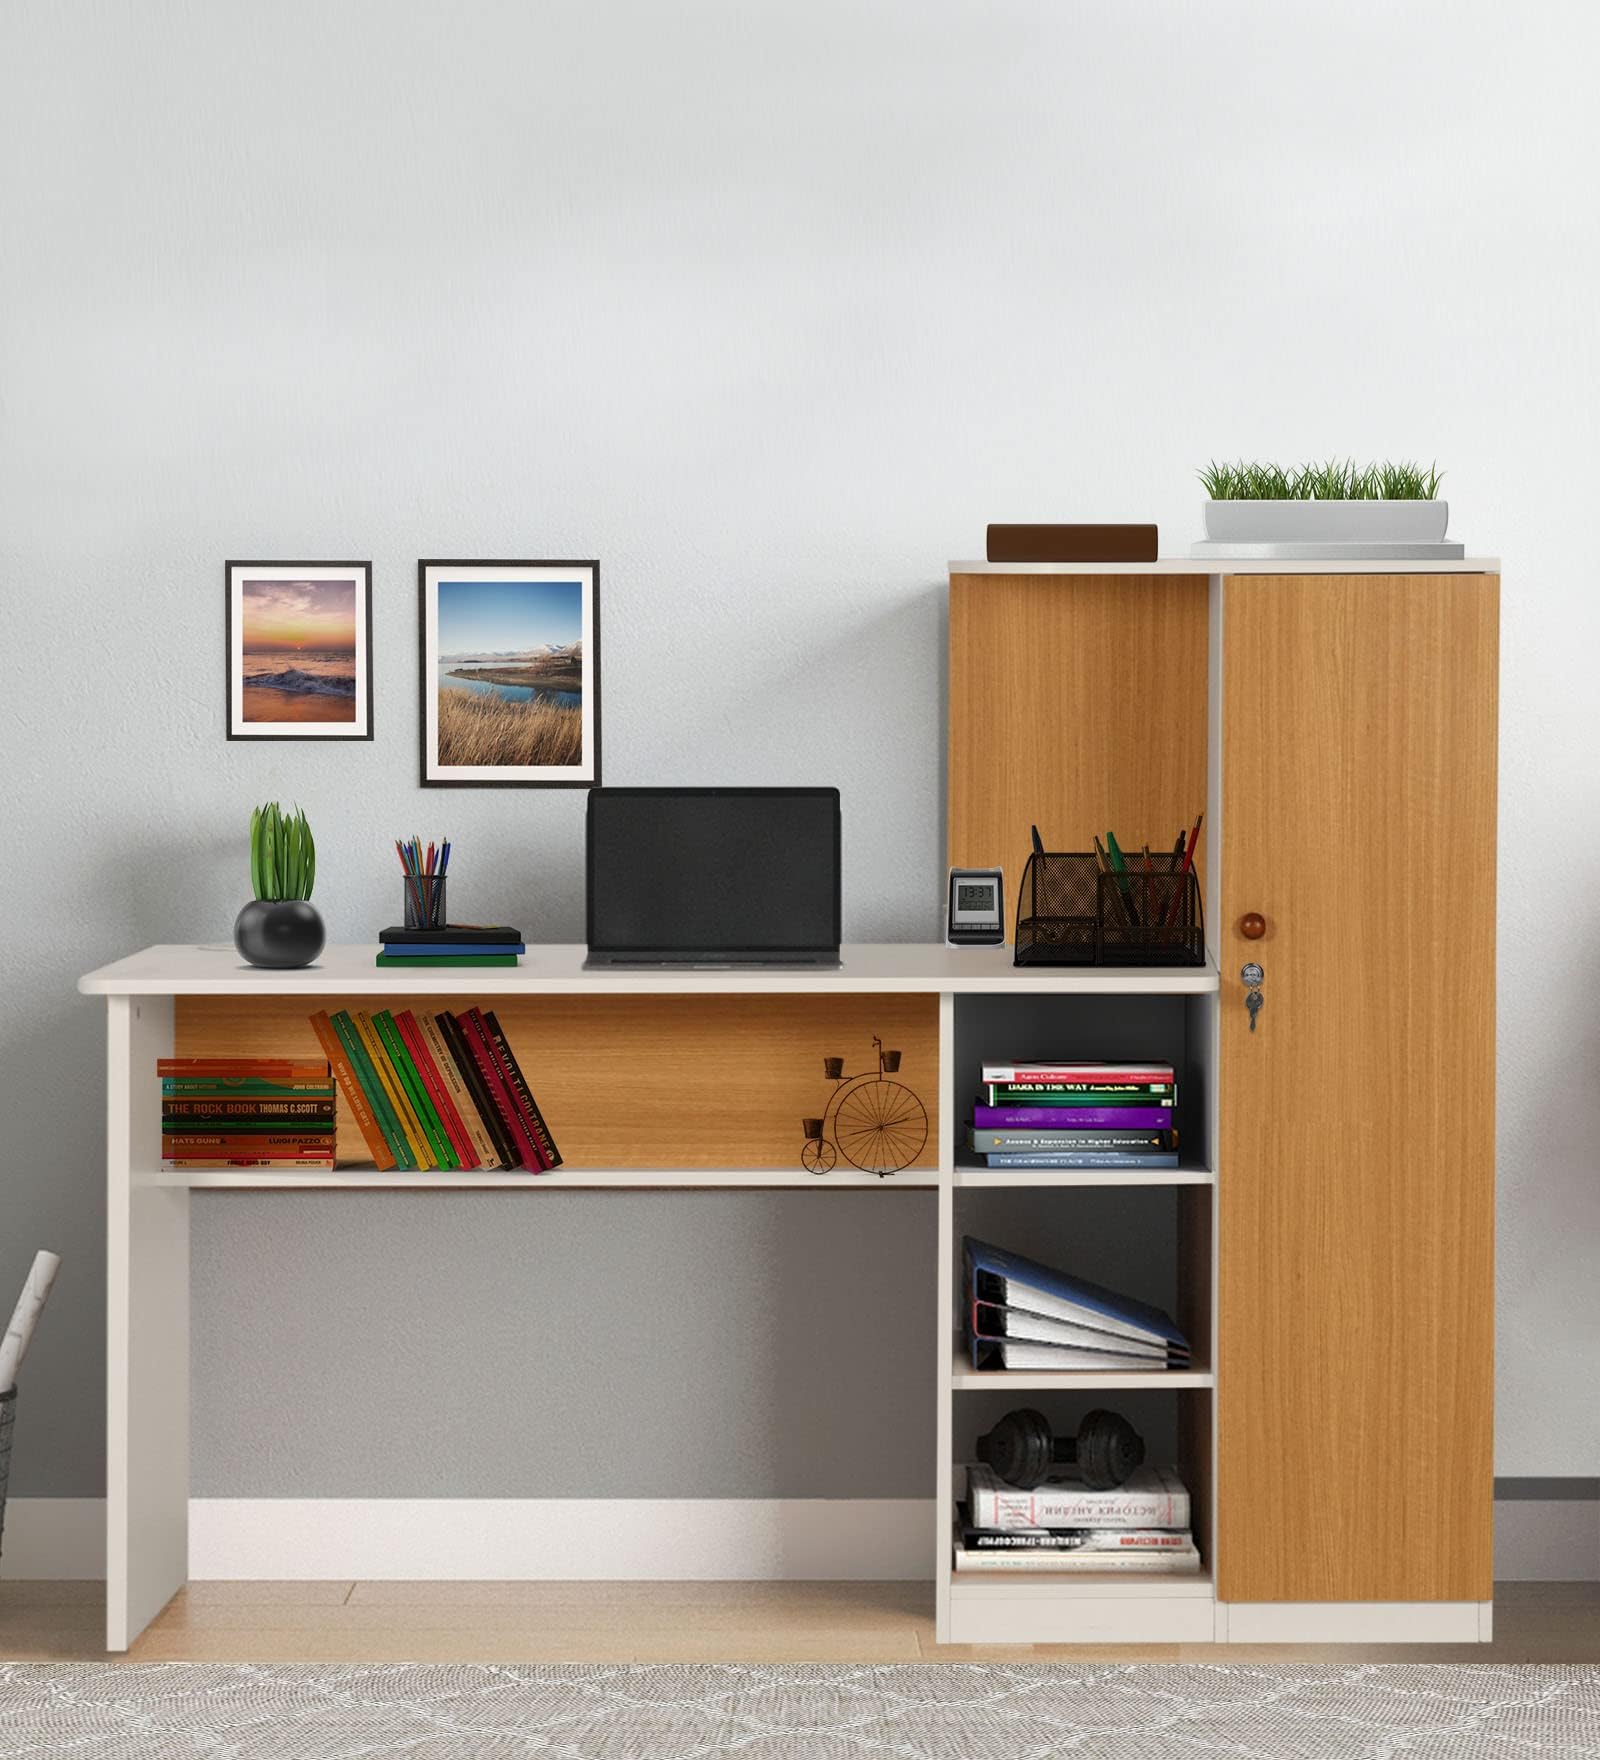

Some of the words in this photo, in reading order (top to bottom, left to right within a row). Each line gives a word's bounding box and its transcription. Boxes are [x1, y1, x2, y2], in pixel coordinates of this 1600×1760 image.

[168, 1103, 189, 1114] THE
[193, 1103, 223, 1114] ROCK
[227, 1103, 257, 1114] BOOK
[259, 1103, 289, 1114] THOMAS
[290, 1103, 318, 1114] C.SCOTT
[352, 1094, 364, 1112] LOVE
[359, 1109, 371, 1127] CATS
[268, 1137, 291, 1145] LUIGI
[292, 1137, 320, 1145] PAZZO
[1044, 1504, 1093, 1515] АНГЛИИ
[1099, 1504, 1157, 1515] ИСТОРИЯ
